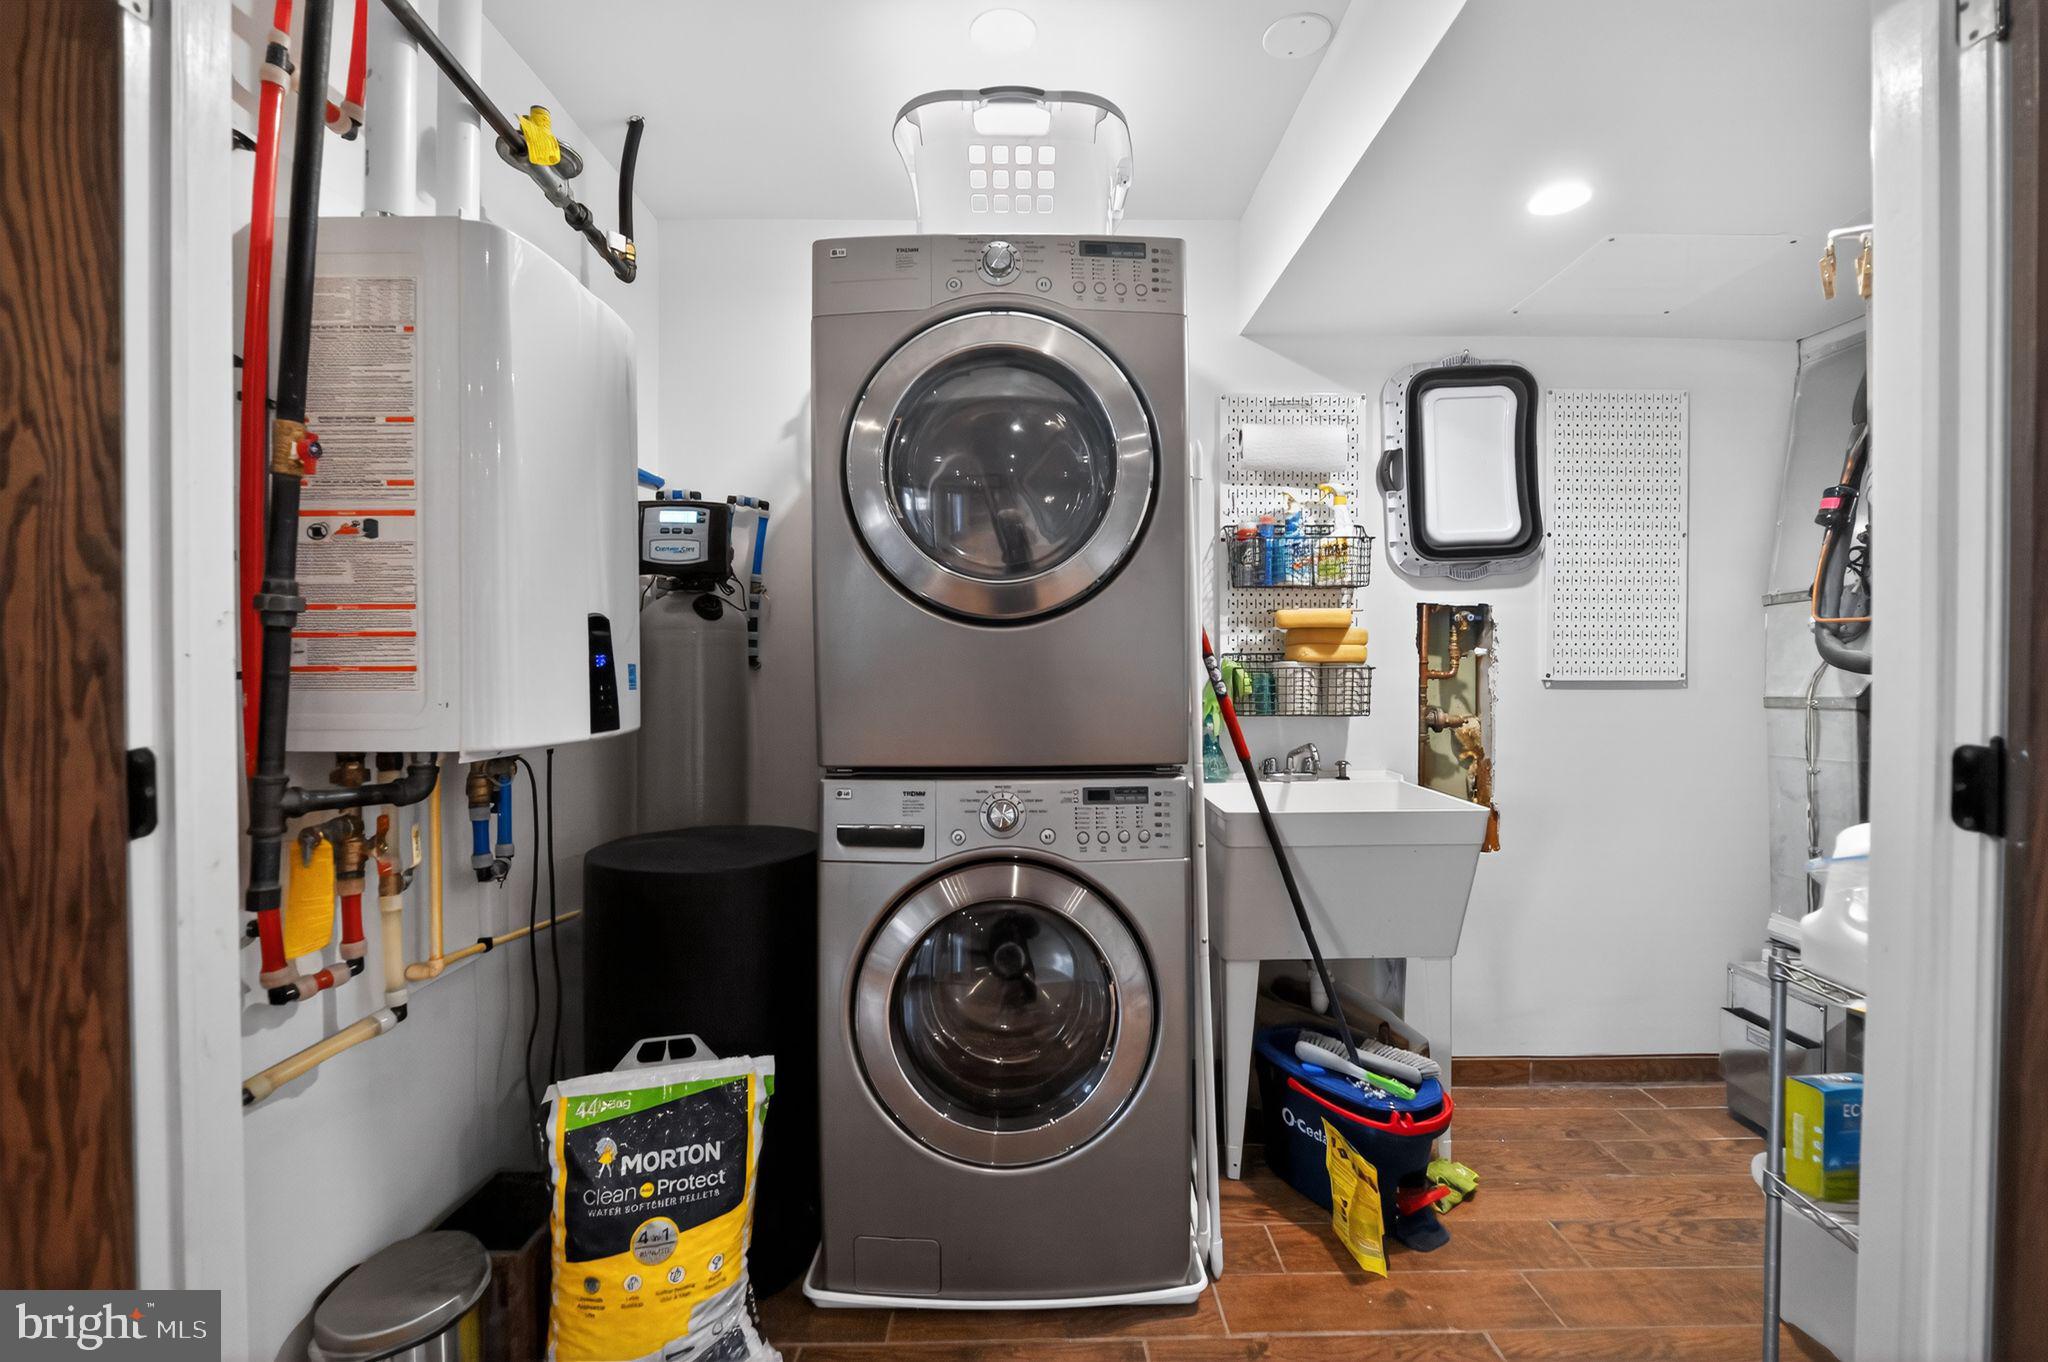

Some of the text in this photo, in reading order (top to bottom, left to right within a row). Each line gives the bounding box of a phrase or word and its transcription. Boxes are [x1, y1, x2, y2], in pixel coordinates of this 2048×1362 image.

[575, 1097, 598, 1119] 44
[1843, 1104, 1862, 1118] EC
[1282, 1107, 1327, 1146] O-Ceda
[620, 1141, 722, 1176] MORTON
[583, 1169, 727, 1206] Clean Protect
[587, 1188, 721, 1218] WATER SOFTENER PELLETS
[636, 1230, 649, 1244] 4
[662, 1227, 670, 1241] 1
